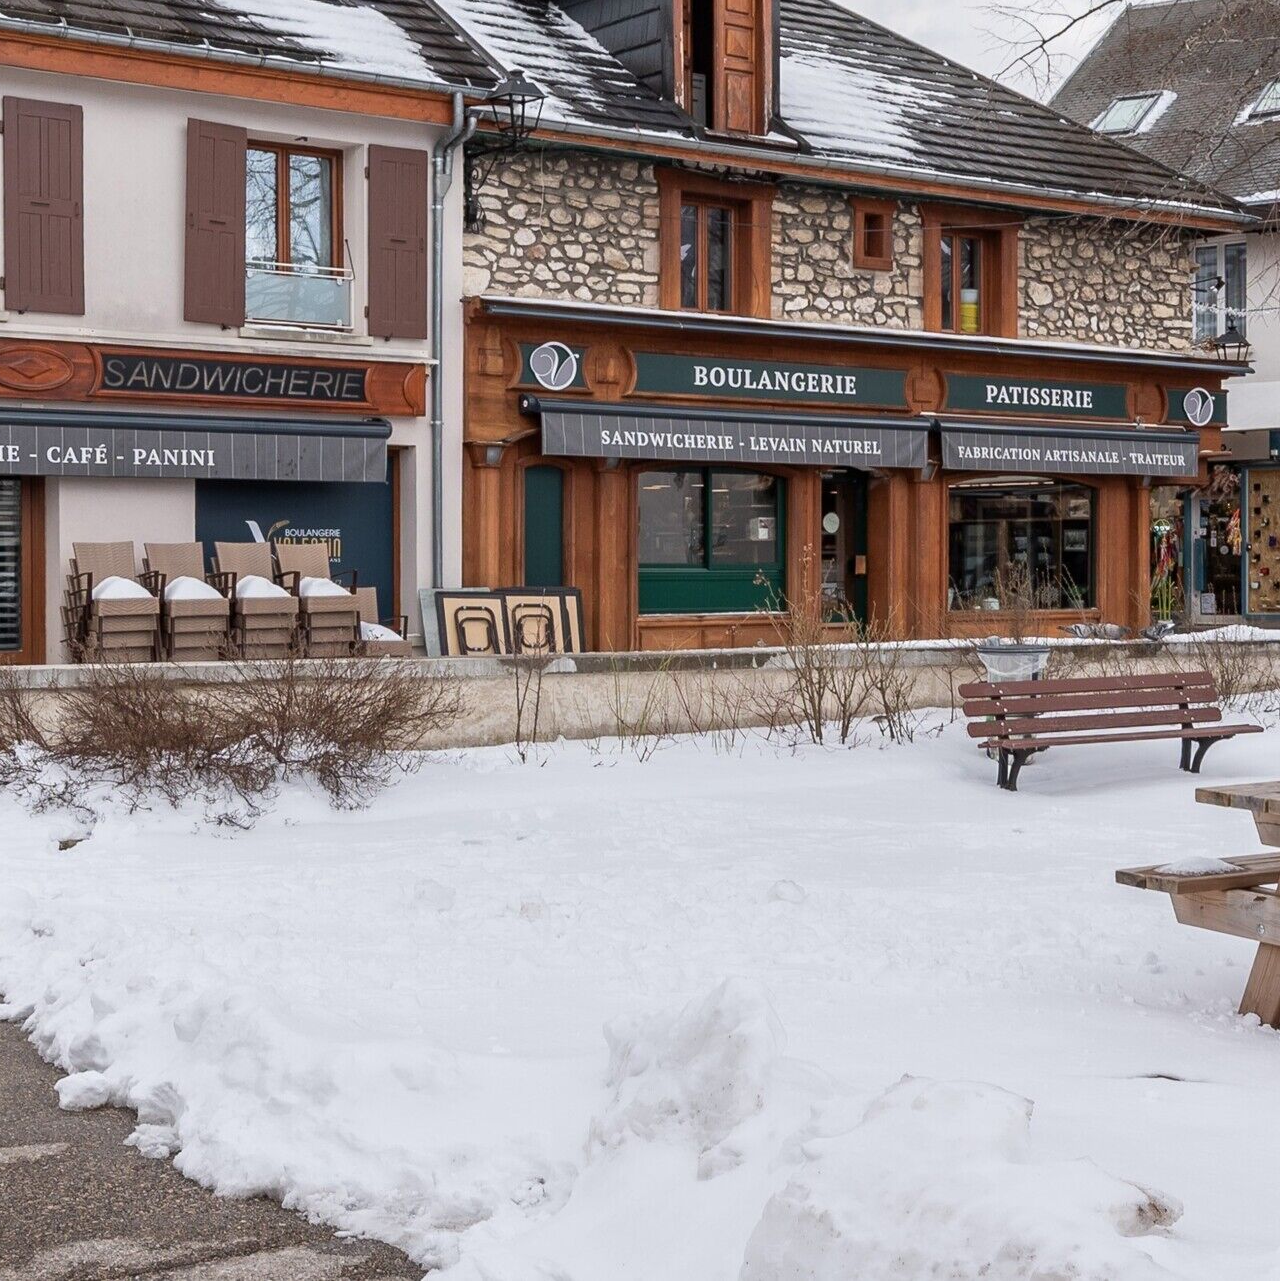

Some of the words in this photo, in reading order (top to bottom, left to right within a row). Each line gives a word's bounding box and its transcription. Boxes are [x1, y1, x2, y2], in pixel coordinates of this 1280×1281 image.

[104, 359, 363, 399] SANDWICHERIE
[693, 365, 857, 395] BOULANGERIE
[985, 384, 1093, 409] PATISSERIE
[46, 443, 108, 464] CAFÉ
[132, 448, 216, 466] PANINI
[600, 429, 734, 450] SANDWICHERIE
[749, 436, 806, 453] LEVAIN
[811, 438, 882, 455] NATUREL
[957, 445, 1041, 461] FABRICATION
[1044, 449, 1120, 464] ARTISANALE
[1129, 451, 1186, 467] TRAITEUR
[285, 528, 341, 537] BOULANGERIE
